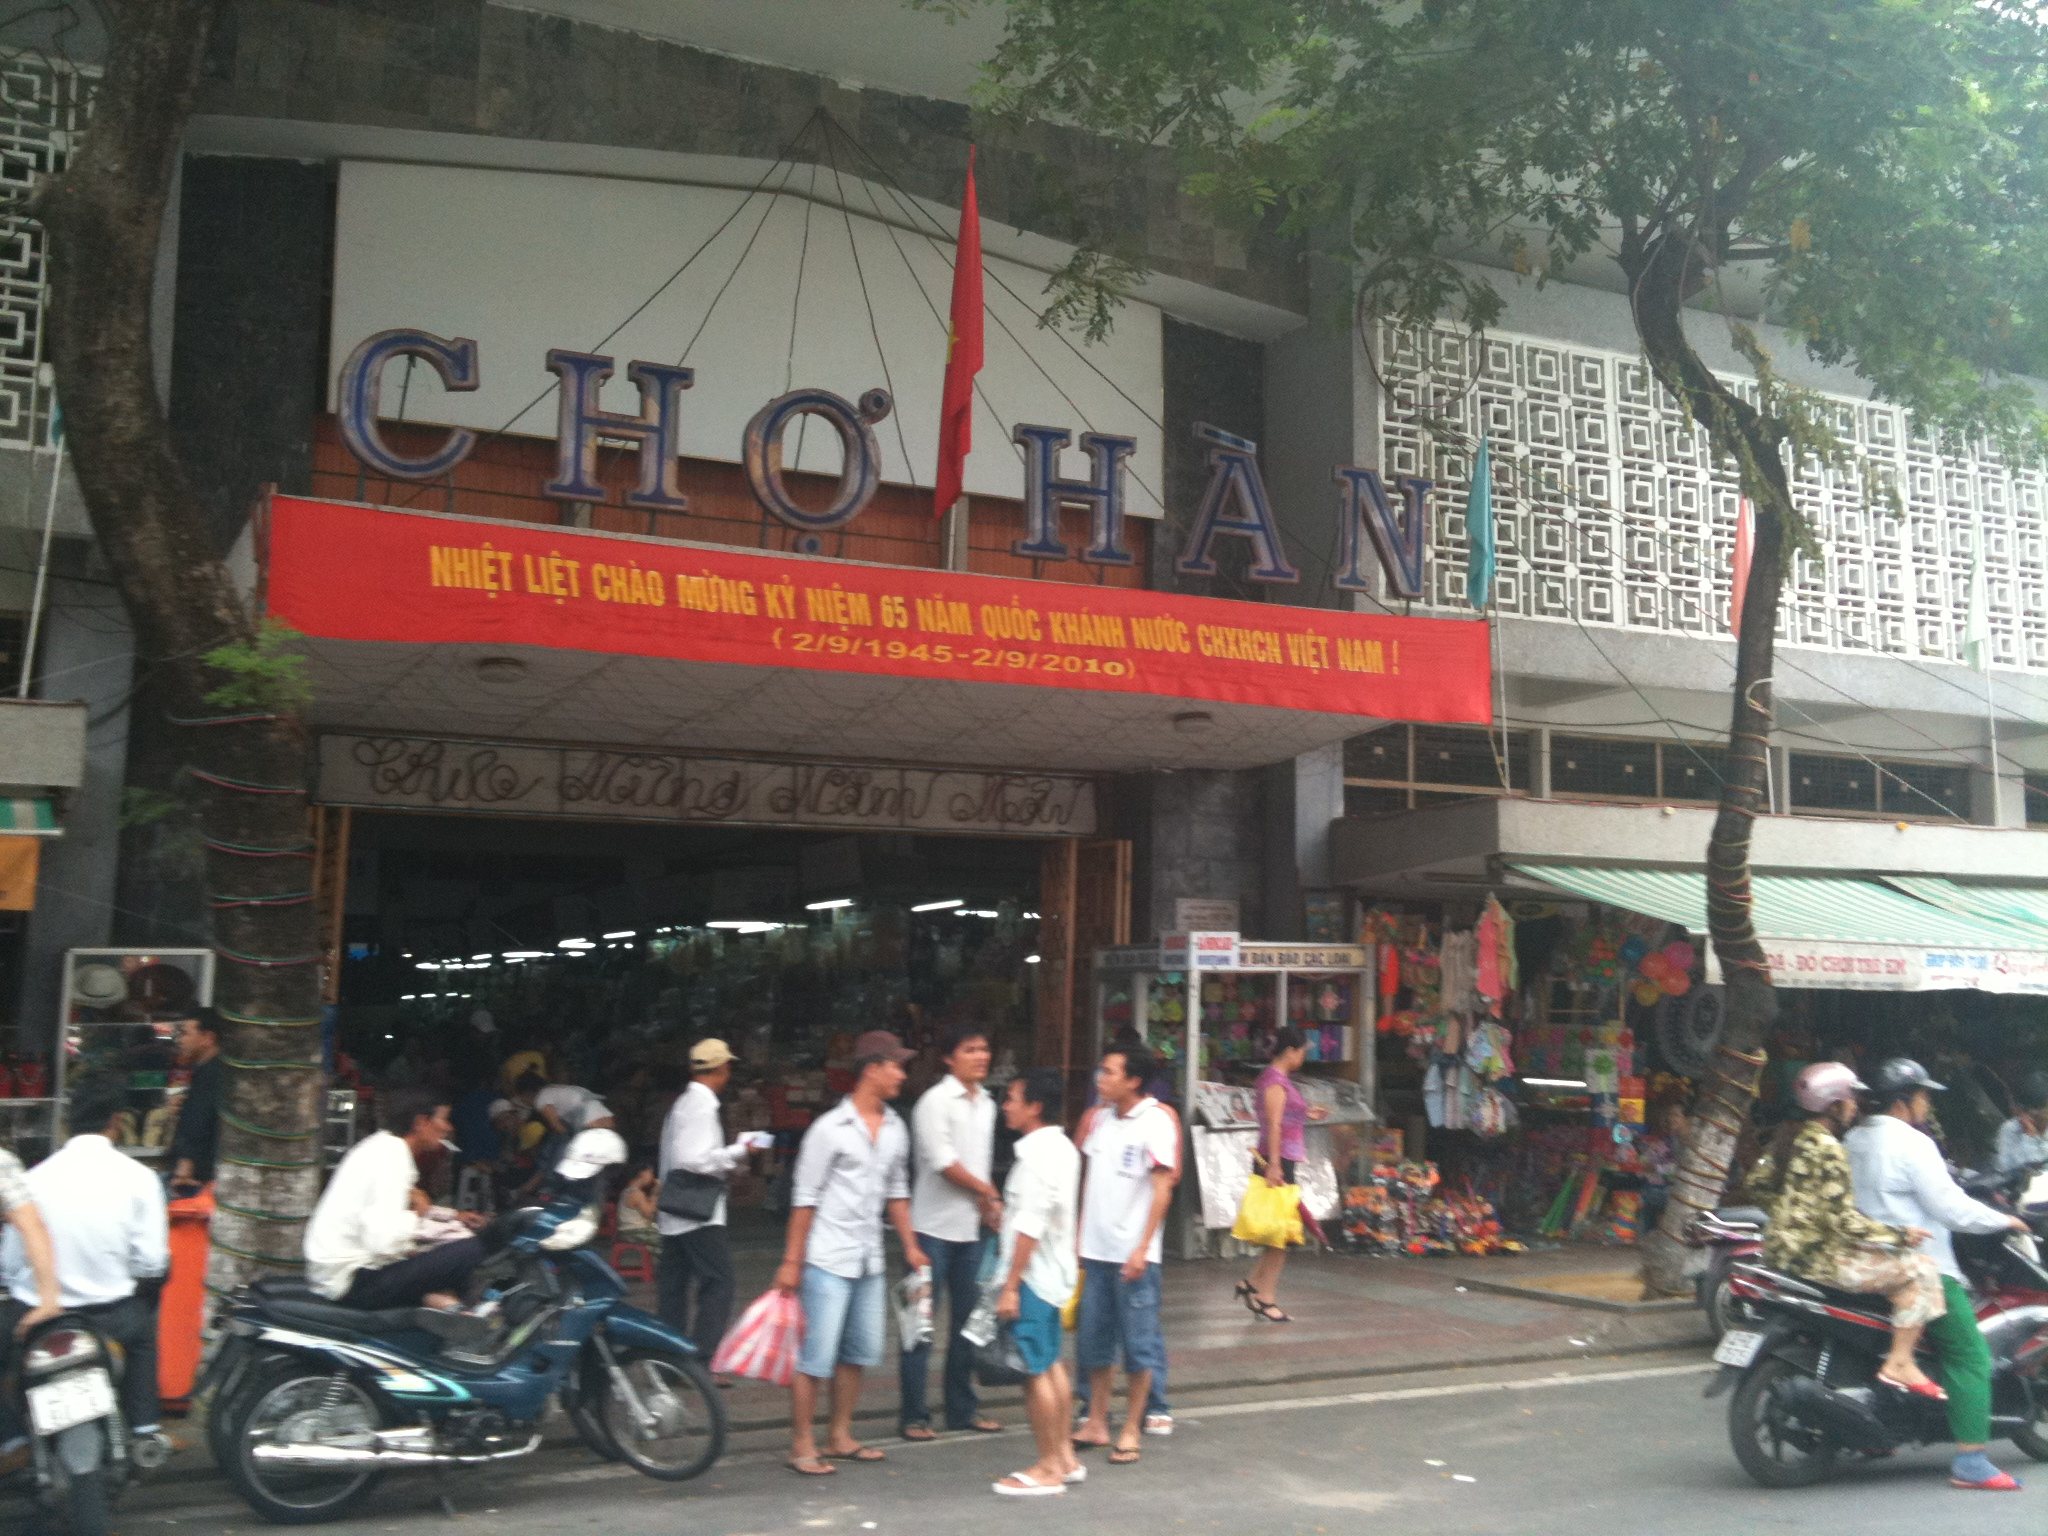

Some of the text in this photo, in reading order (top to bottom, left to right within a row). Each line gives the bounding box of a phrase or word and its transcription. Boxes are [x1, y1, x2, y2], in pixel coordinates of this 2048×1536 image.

[340, 328, 1437, 600] CHỢ HÀN
[430, 541, 513, 599] NHIỆT
[522, 549, 581, 605] LIỆT
[591, 560, 665, 607] CHÀO
[676, 568, 758, 616] MỪNG
[762, 574, 796, 619] KỶ
[804, 582, 873, 632] NIỆM
[879, 594, 909, 628] 65
[915, 591, 974, 635] NĂM
[979, 594, 1042, 641] QUỐC
[1048, 606, 1126, 648] KHÁNH
[1130, 612, 1192, 653] NƯỚC
[1196, 623, 1283, 664] CHXHCN
[1286, 628, 1330, 675] VIỆT
[1336, 638, 1385, 674] NAM
